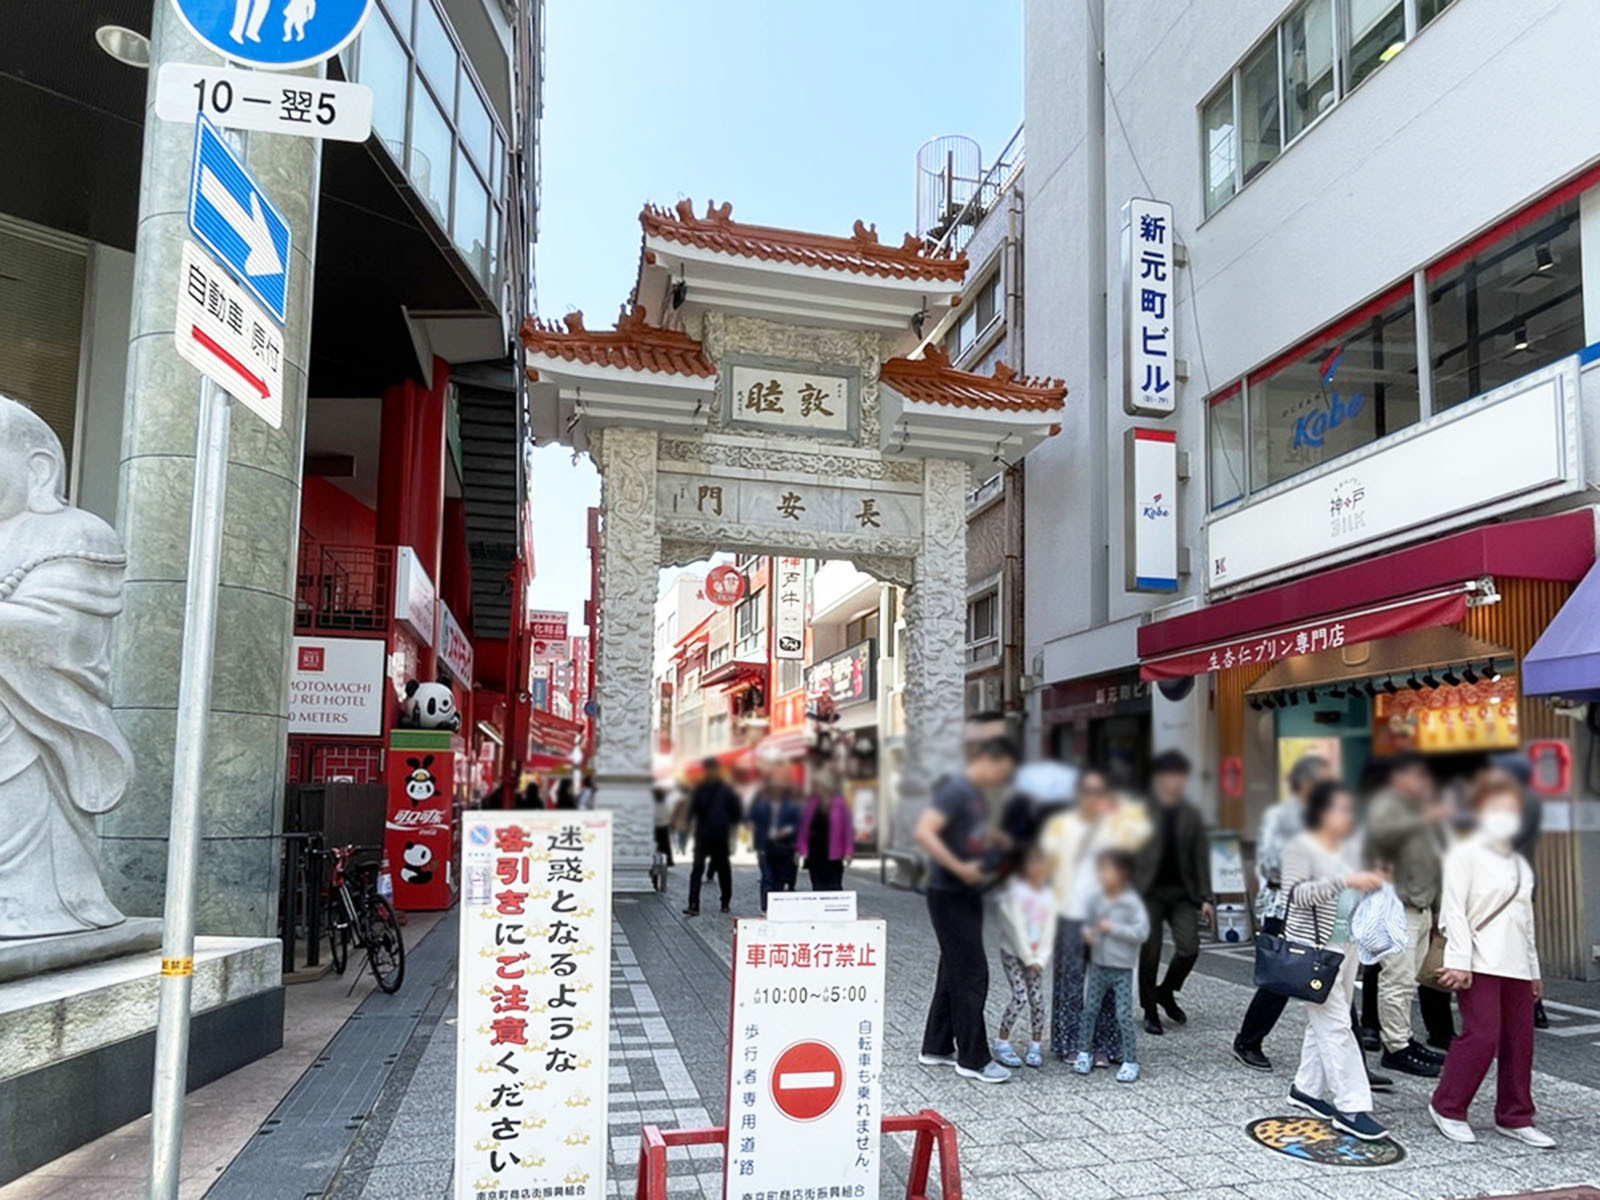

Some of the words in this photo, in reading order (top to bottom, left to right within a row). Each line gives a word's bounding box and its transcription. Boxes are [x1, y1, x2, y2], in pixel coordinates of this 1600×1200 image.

[1140, 212, 1171, 394] 新元町ビル
[1291, 390, 1366, 449] Kobe
[1143, 505, 1170, 520] Kobe
[1207, 623, 1345, 671] 生杏仁プリン専門店
[299, 712, 349, 724] METERS
[323, 695, 367, 707] HOTEL
[545, 824, 584, 1073] 迷惑となるような
[745, 943, 877, 969] 車両通行禁止
[489, 825, 533, 1174] 客引きにご注意ください
[739, 1023, 759, 1176] 歩行者専用道路
